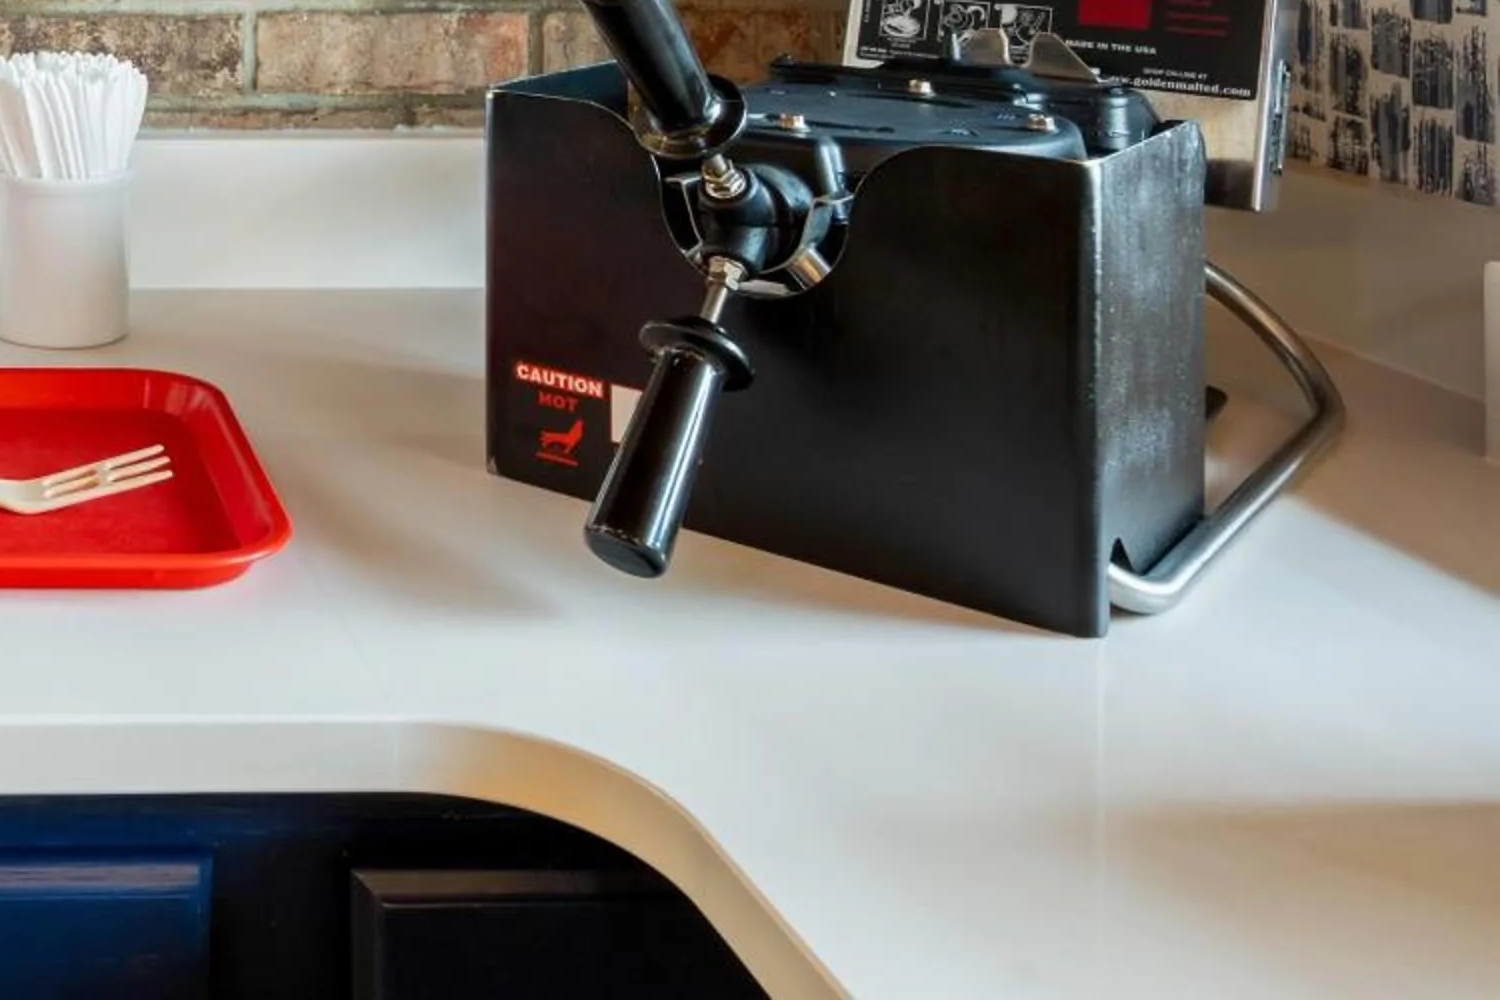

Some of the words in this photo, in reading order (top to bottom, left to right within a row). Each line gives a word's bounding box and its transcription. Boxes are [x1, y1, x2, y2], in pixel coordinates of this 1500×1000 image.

[1111, 43, 1132, 53] THE
[1134, 45, 1157, 55] USA
[1104, 76, 1252, 97] ww.goldenmalted.com
[515, 361, 605, 398] CAUTION
[537, 391, 580, 413] HOT
